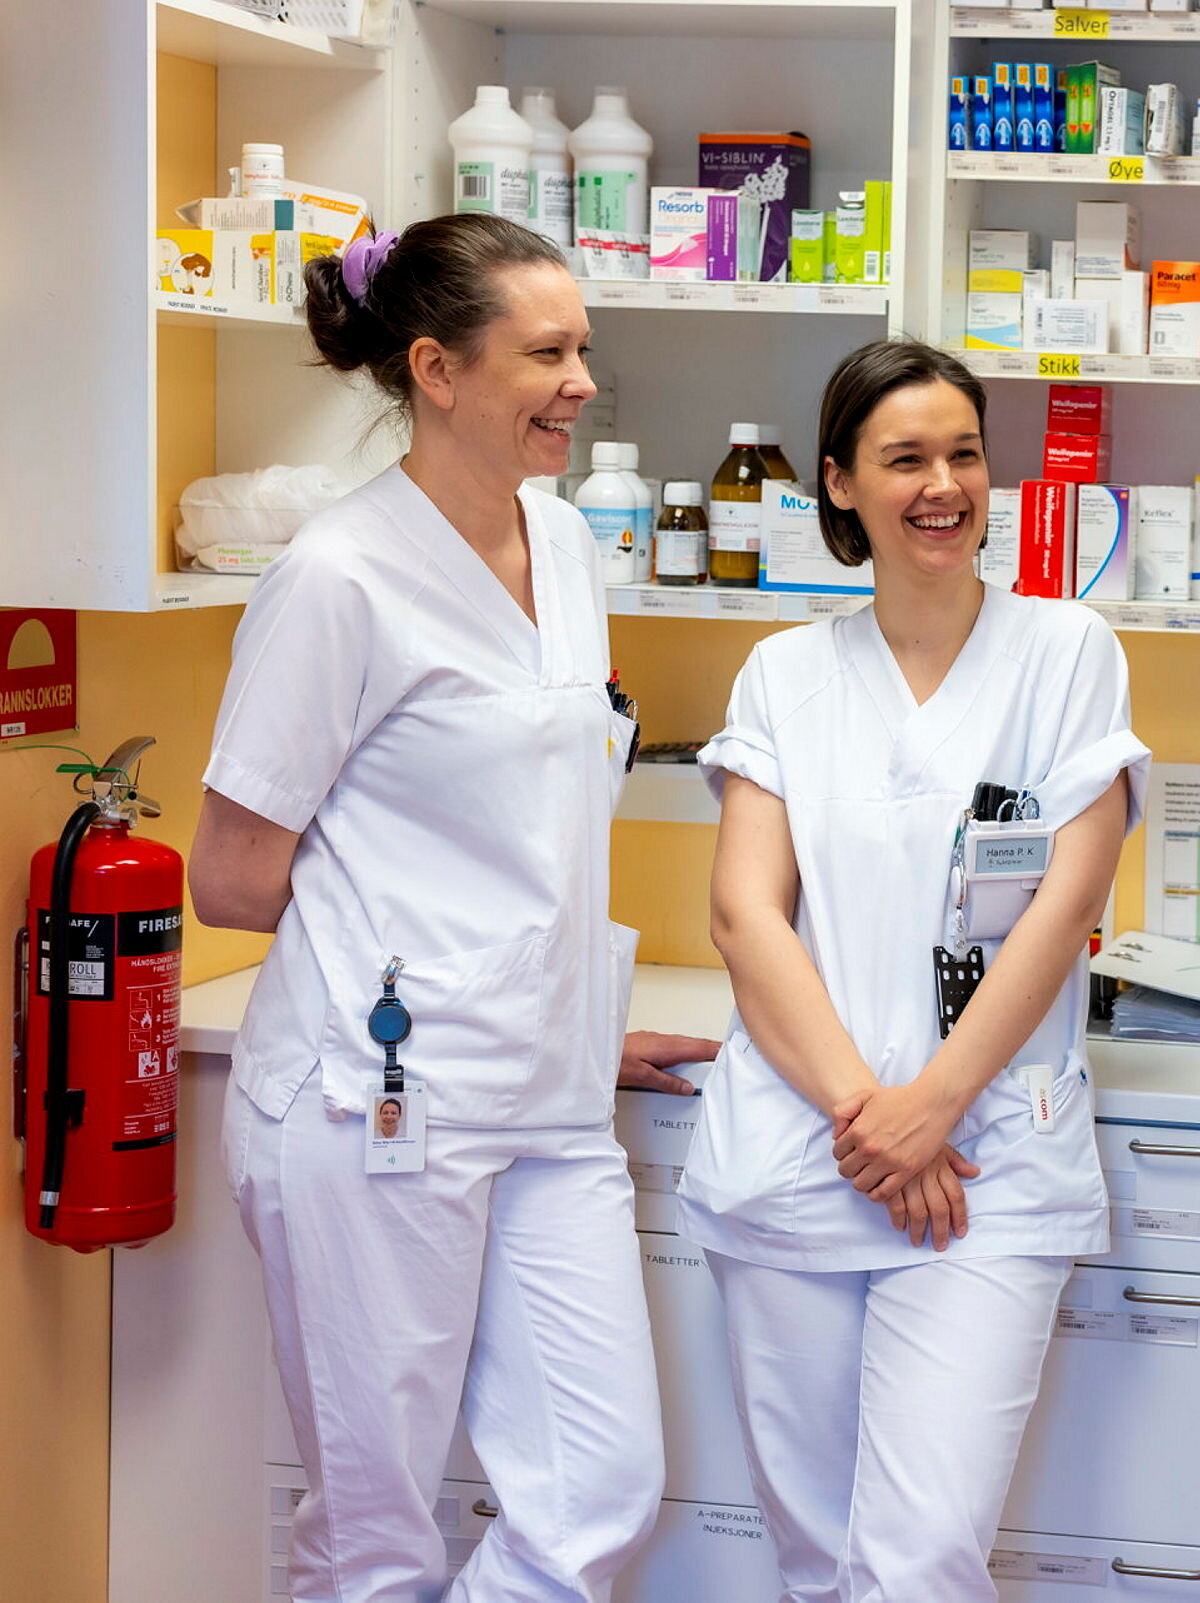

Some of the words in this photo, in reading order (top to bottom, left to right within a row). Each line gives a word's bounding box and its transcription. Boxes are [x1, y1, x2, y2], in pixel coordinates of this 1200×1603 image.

[1054, 16, 1109, 34] Salver
[701, 151, 765, 165] VI-SIBLIN
[1108, 160, 1144, 181] Øye
[658, 199, 705, 214] Resorb
[1157, 271, 1196, 281] Paracet
[1039, 357, 1080, 375] Stikk
[1043, 486, 1056, 547] Weifapenin
[986, 848, 1015, 858] Hanna
[1027, 847, 1035, 856] K
[653, 1118, 698, 1131] TABLETT
[646, 1254, 700, 1267] TABLETTER
[702, 1524, 763, 1540] INJEKSJONER
